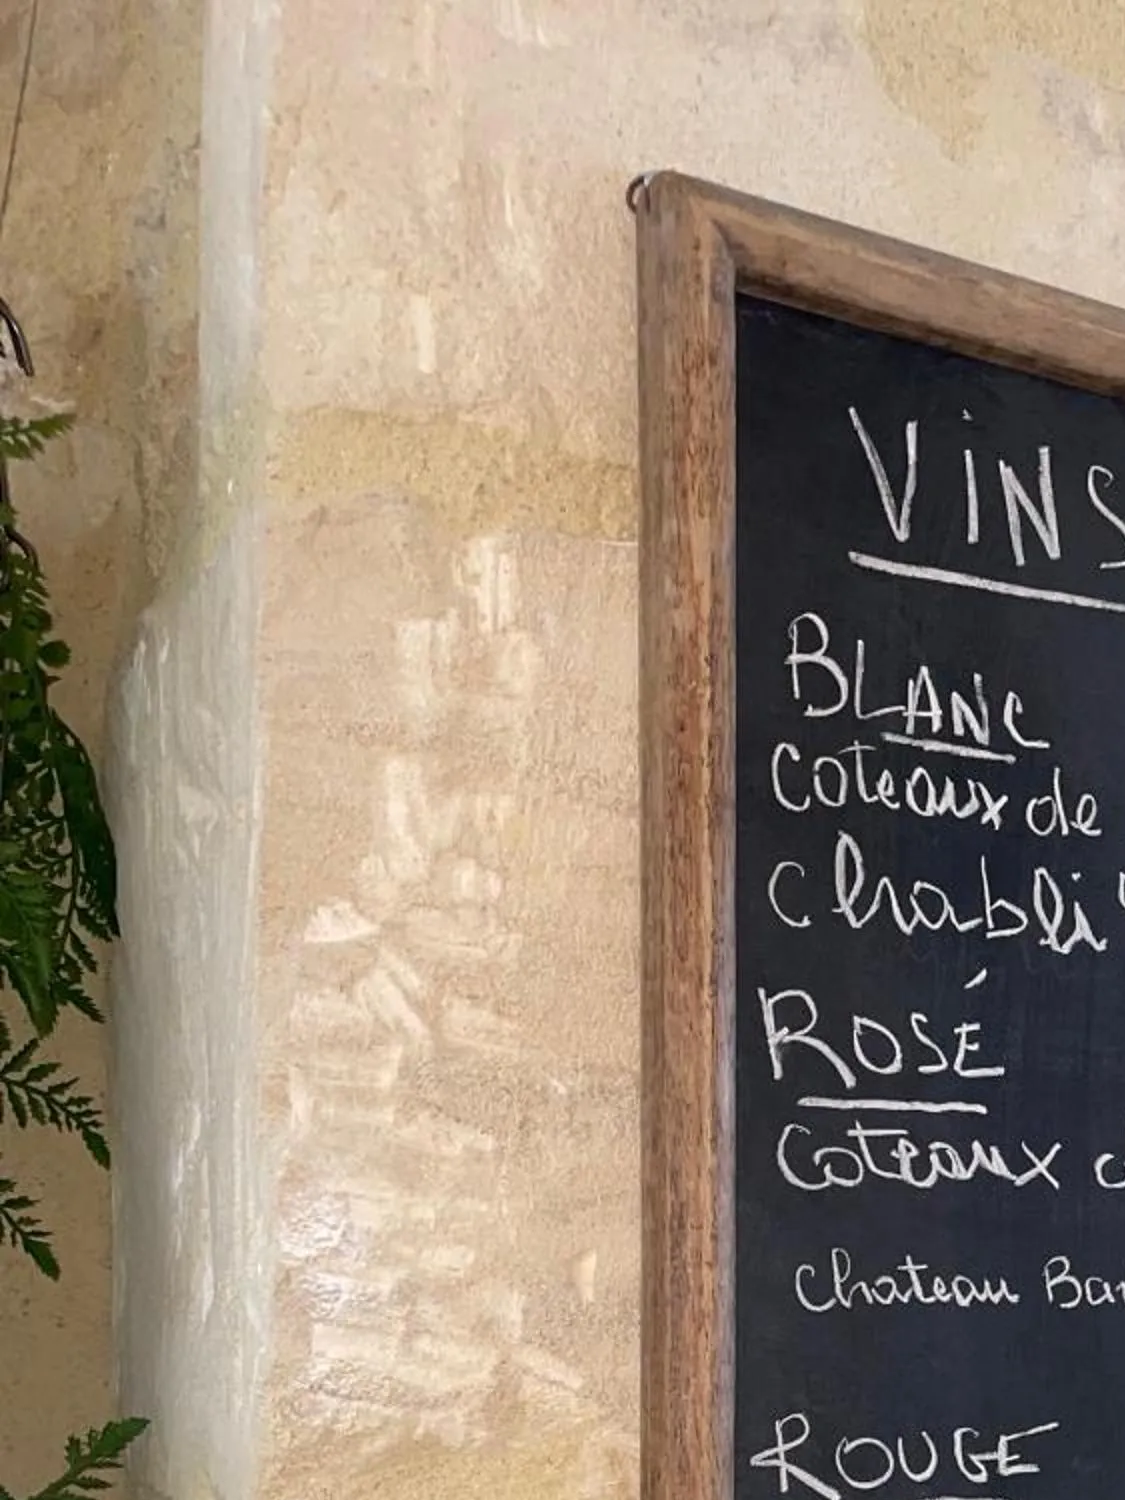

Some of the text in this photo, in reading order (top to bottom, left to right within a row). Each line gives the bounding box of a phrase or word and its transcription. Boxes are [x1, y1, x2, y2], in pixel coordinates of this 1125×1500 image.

[784, 612, 1049, 748] BLANC
[1026, 767, 1102, 838] de
[757, 967, 1005, 1089] ROSÉ
[776, 1119, 1064, 1191] Coteaux
